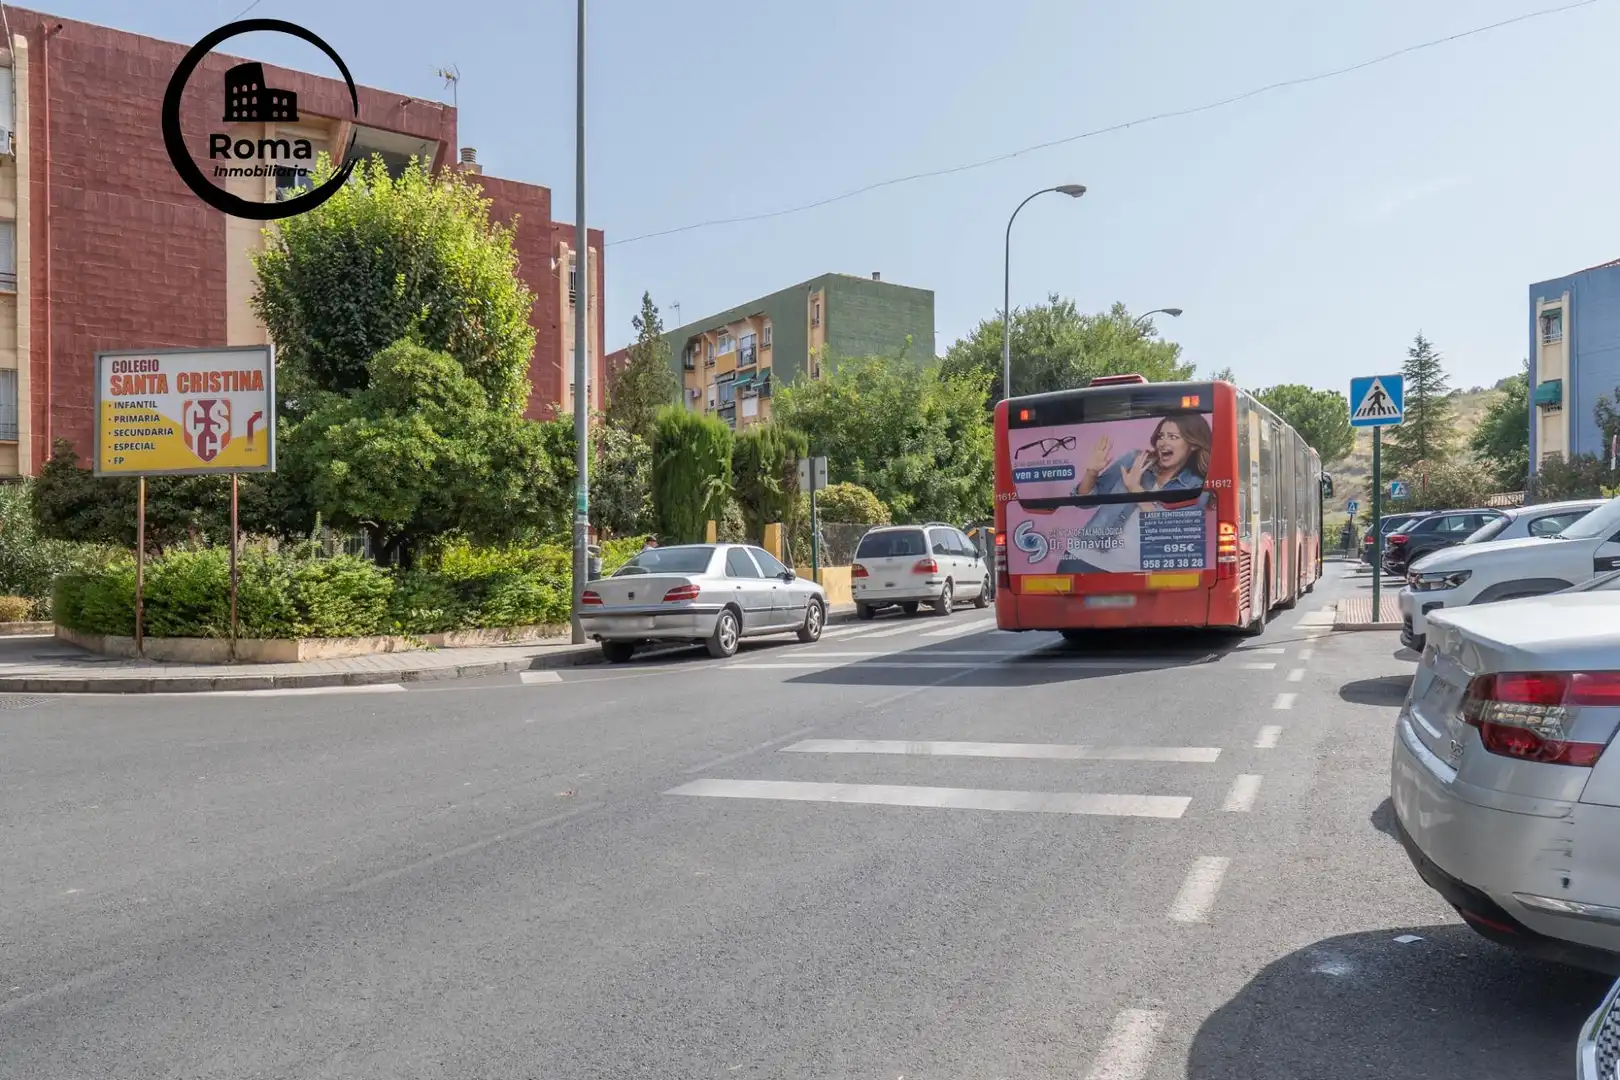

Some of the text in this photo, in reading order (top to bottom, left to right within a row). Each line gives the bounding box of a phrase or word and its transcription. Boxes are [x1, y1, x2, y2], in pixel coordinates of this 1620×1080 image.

[112, 359, 160, 374] COLEGIO
[110, 370, 265, 396] SANTA CRISTINA
[114, 401, 158, 410] INFANTIL
[114, 415, 160, 423] PRIMARIA
[113, 428, 174, 437] SECUNDARIA
[113, 442, 156, 451] ESPECIAL
[113, 457, 125, 465] FP
[1015, 468, 1073, 480] ven a vernos
[1205, 479, 1232, 488] 11612
[1049, 537, 1125, 550] Dr. Benavides
[1164, 543, 1195, 553] 695€
[1143, 558, 1204, 569] 958 28 38 28
